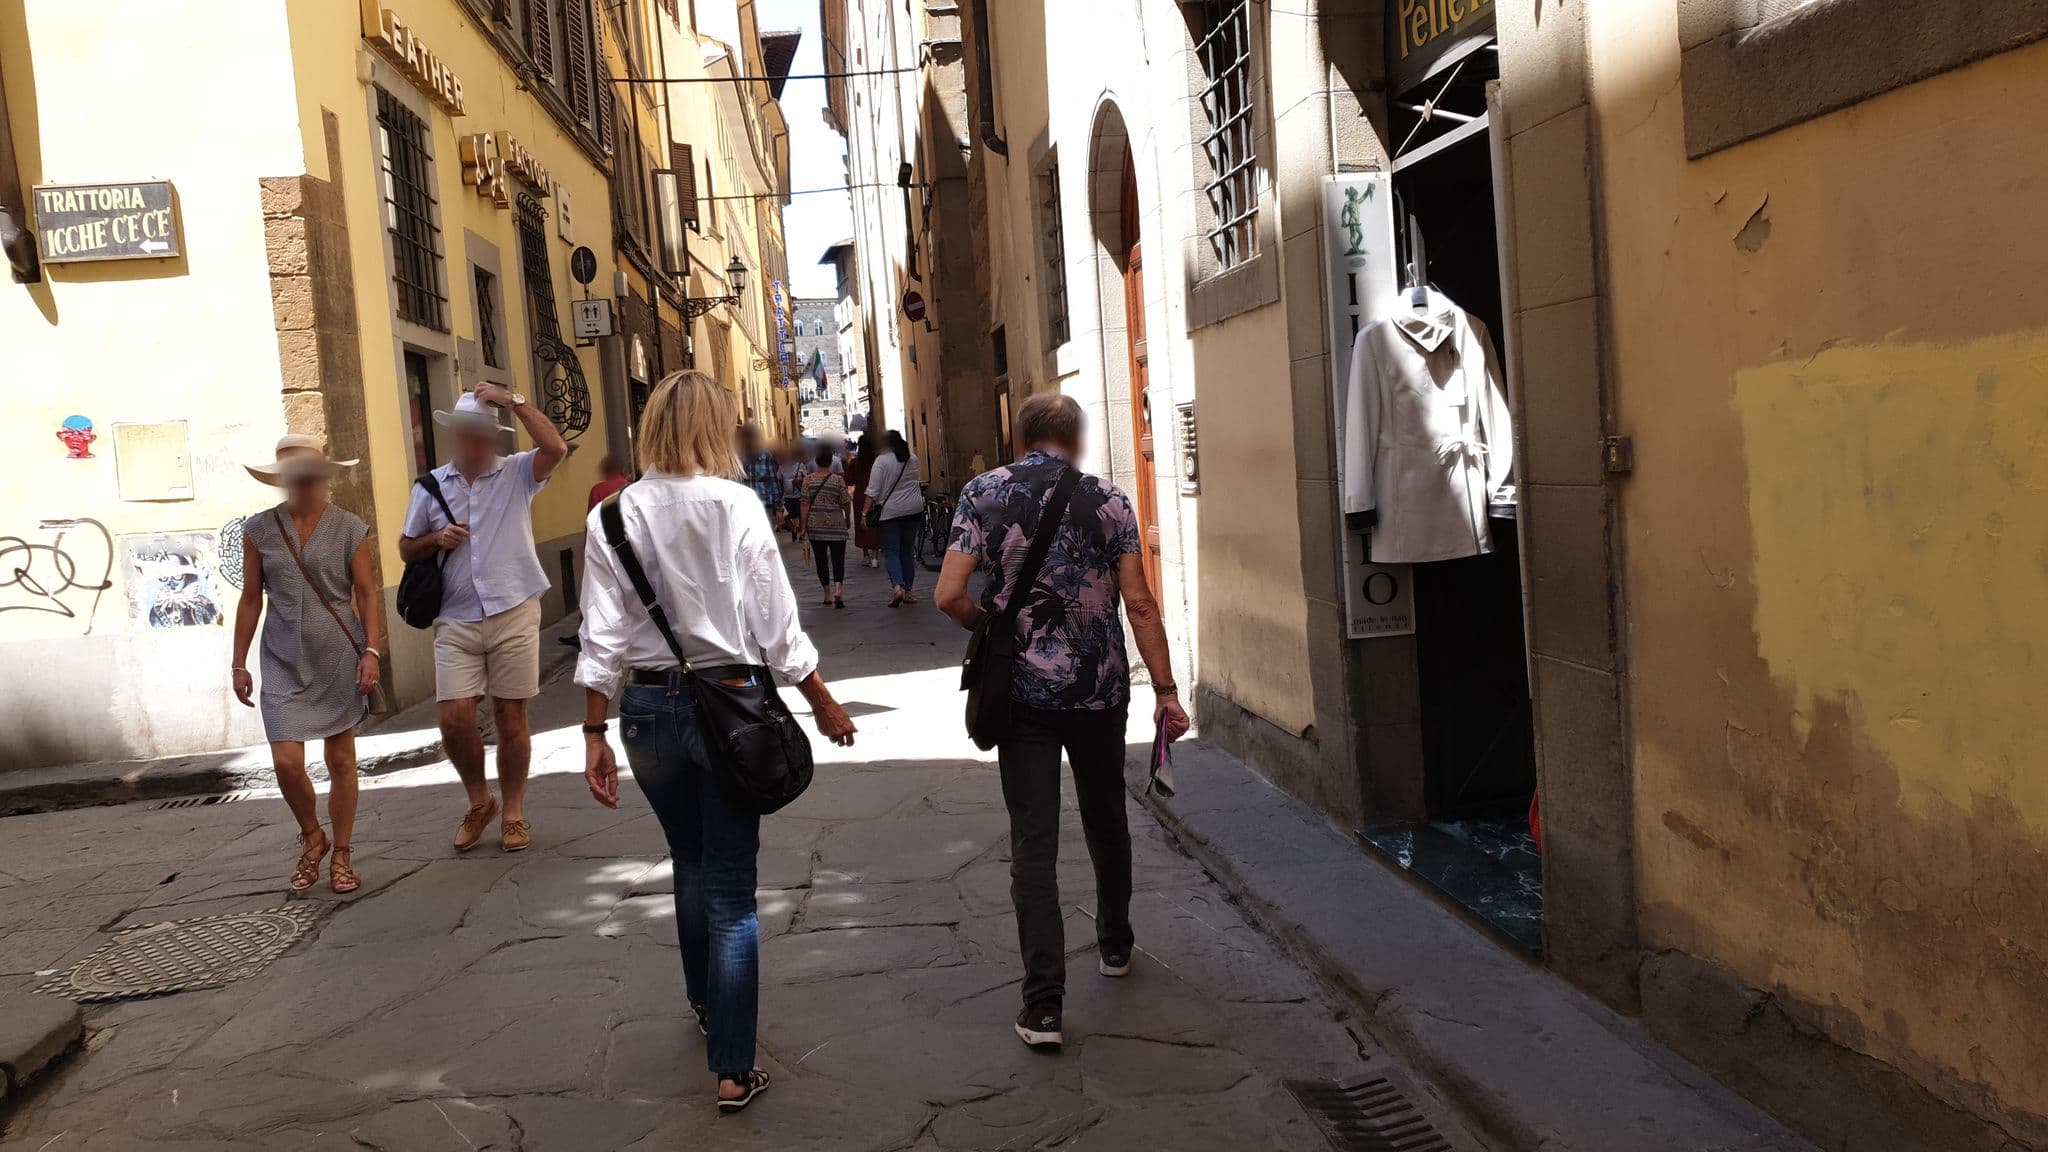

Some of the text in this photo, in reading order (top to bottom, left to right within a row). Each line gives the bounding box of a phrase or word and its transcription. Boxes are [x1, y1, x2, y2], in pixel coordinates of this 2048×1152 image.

[372, 0, 466, 116] LEATHER
[41, 187, 146, 213] TRATTORIA
[772, 280, 789, 386] TRATTORIA
